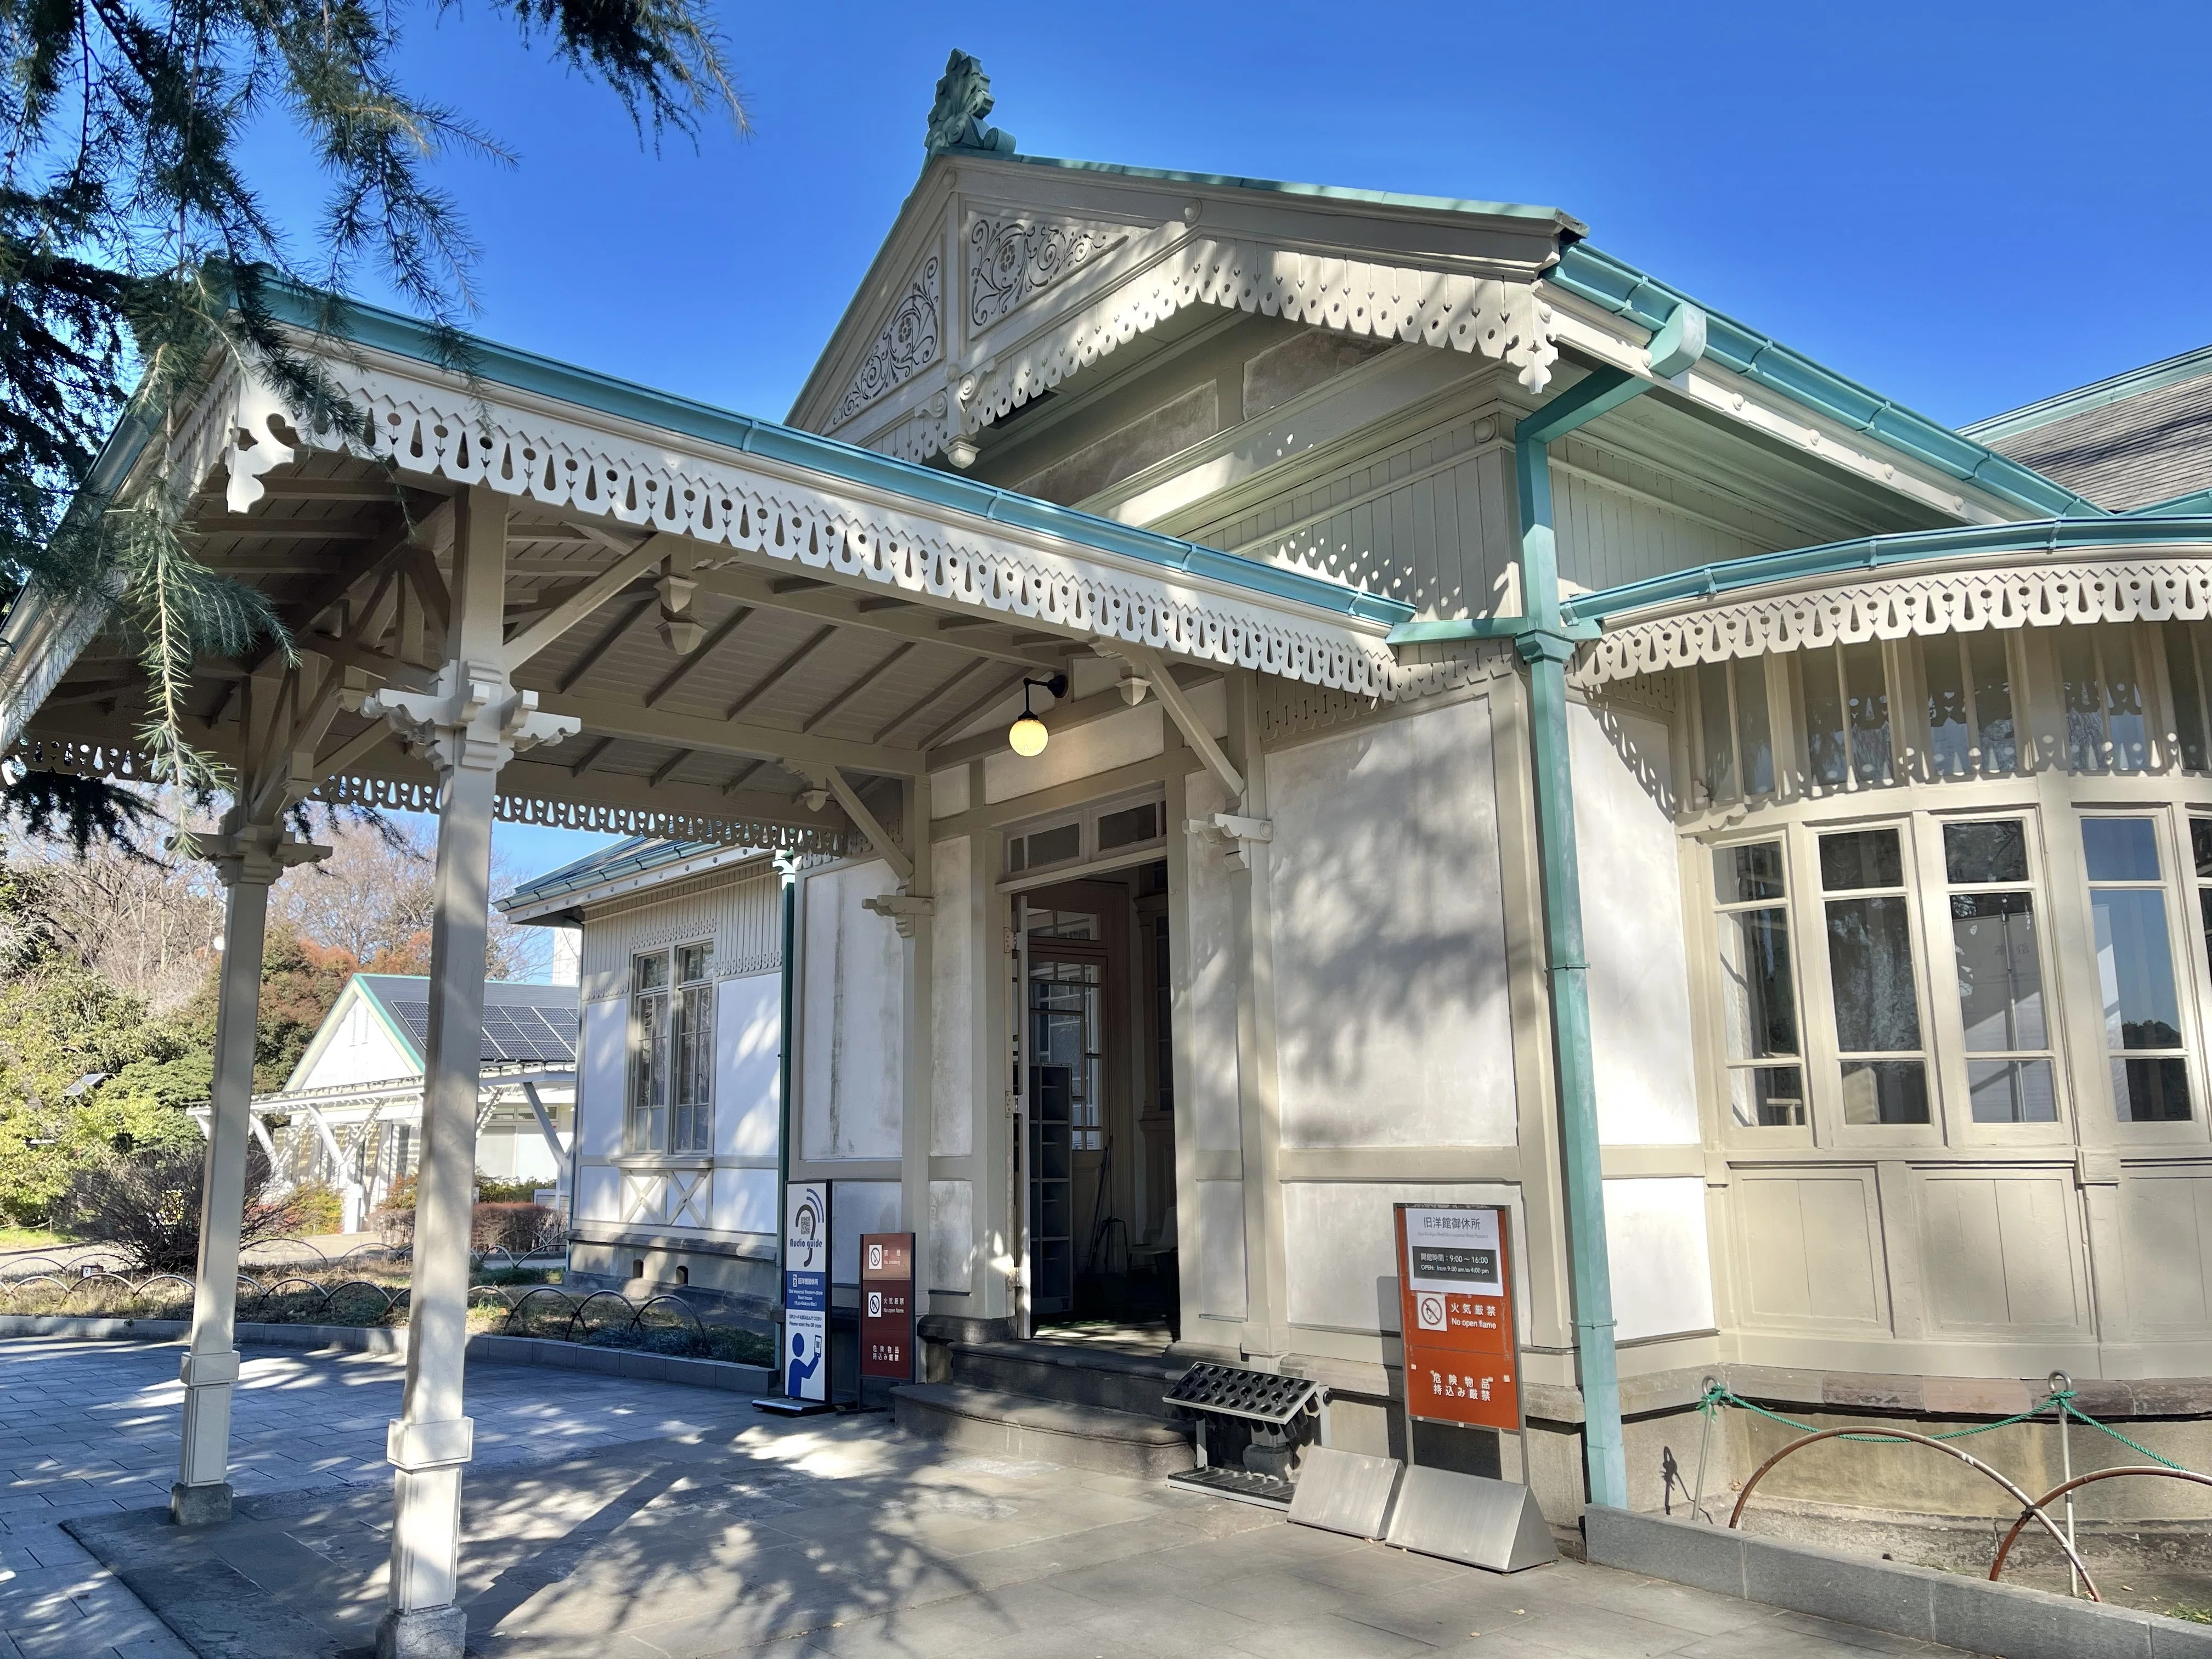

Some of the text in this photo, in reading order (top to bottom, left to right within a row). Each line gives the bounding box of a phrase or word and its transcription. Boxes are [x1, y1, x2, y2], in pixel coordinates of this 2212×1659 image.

[1424, 1217, 1481, 1230] 旧洋館御休所
[790, 1238, 822, 1250] Audio guide
[1451, 1303, 1496, 1316] 火気厳禁
[1479, 1320, 1497, 1329] flame
[1433, 1373, 1490, 1390] 危険物品
[1433, 1384, 1491, 1401] 持込み厳禁
